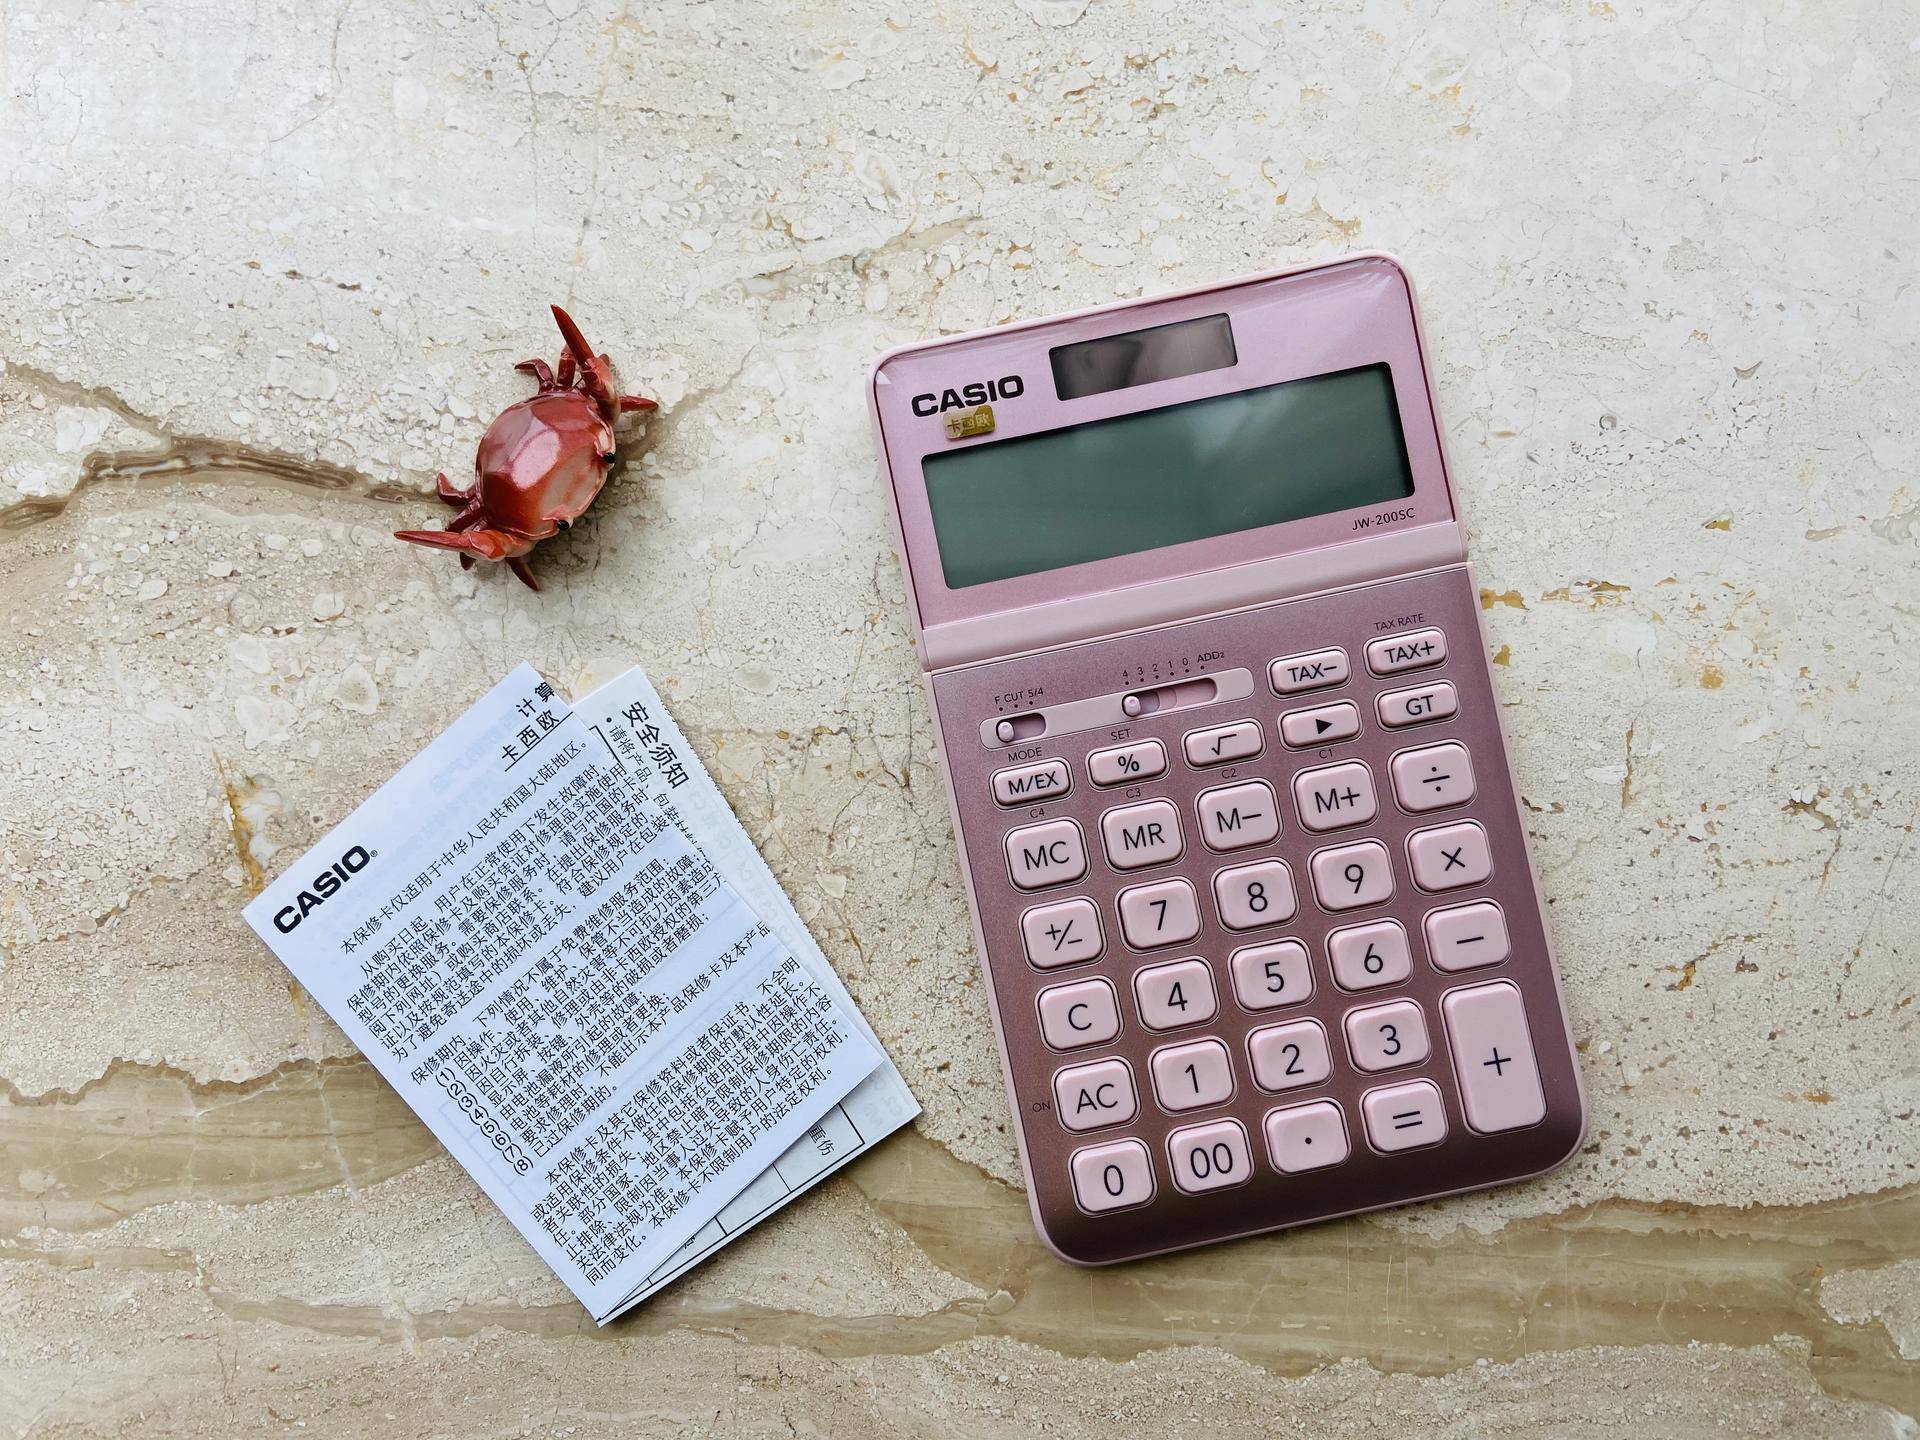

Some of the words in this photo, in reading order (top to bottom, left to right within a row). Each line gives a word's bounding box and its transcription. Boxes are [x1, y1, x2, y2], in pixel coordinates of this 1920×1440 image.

[912, 375, 1024, 417] CASIO
[947, 413, 990, 433] 卡西欧
[1352, 508, 1416, 531] JW-200SC
[1374, 618, 1395, 632] TAX
[1398, 613, 1425, 626] RATE
[1385, 641, 1435, 664] TAX+
[1004, 691, 1024, 703] CUT
[1028, 687, 1044, 699] 5/4
[1406, 694, 1434, 716] GT
[622, 701, 689, 789] 安全须知
[1111, 728, 1131, 741] SET
[1008, 747, 1043, 762] MODE
[1319, 748, 1333, 759] C1
[1008, 771, 1059, 795] M/EX
[1221, 768, 1237, 780] C2
[1126, 788, 1142, 799] C3
[1314, 786, 1360, 813] M+
[1030, 808, 1045, 819] C4
[1123, 823, 1165, 850] MR
[1024, 841, 1070, 870] MC
[273, 845, 370, 933] CASIO
[1345, 864, 1364, 894] 9
[1247, 882, 1268, 912] 8
[1150, 899, 1167, 930] 7
[1363, 943, 1383, 974] 6
[1265, 961, 1285, 992] 5
[1168, 982, 1188, 1012] 4
[1068, 1003, 1092, 1030] C
[1379, 1024, 1400, 1055] 3
[1281, 1043, 1304, 1075] 2
[435, 1067, 455, 1087] (1)
[1185, 1063, 1199, 1094] 1
[446, 1079, 466, 1100] (2)
[1032, 1101, 1051, 1113] ON
[1076, 1083, 1118, 1114] AC
[457, 1092, 478, 1112] (3)
[468, 1105, 489, 1125] (4)
[479, 1117, 500, 1138] (5)
[490, 1130, 511, 1151] (6)
[808, 1124, 835, 1156] 重伤
[501, 1142, 522, 1163] (7)
[1190, 1143, 1233, 1179] 00
[513, 1155, 533, 1176] (8)
[1103, 1164, 1124, 1196] 0
